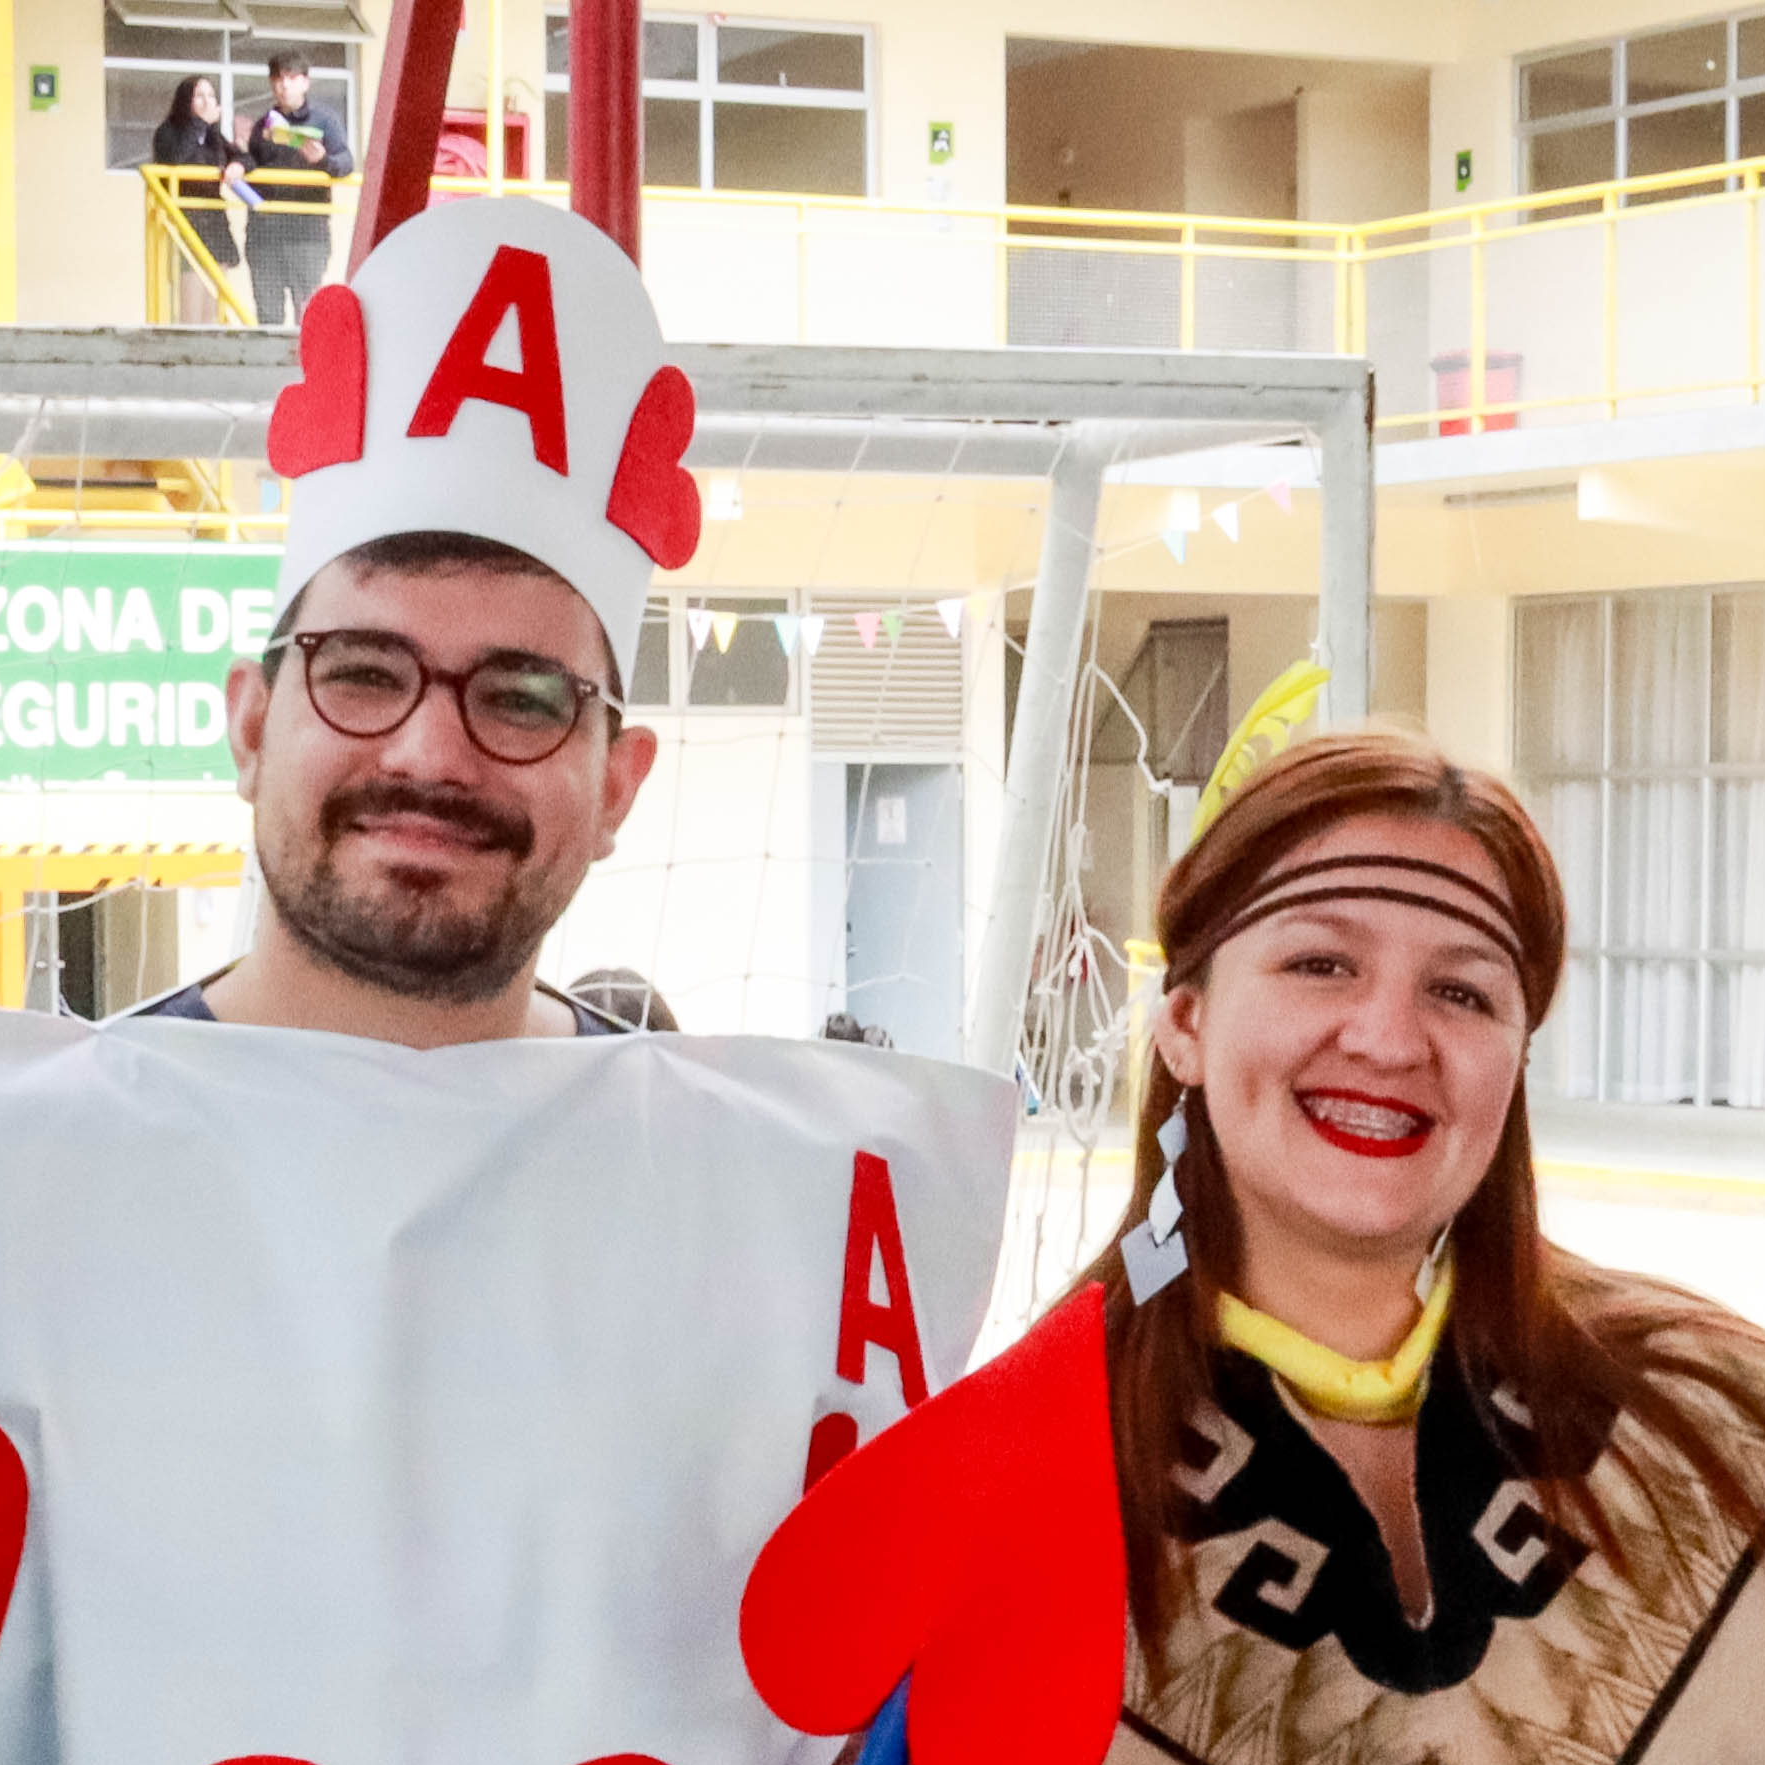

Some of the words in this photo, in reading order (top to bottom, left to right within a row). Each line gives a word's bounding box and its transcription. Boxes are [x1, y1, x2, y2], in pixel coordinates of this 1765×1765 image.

[407, 245, 569, 477] A
[180, 588, 275, 654] DE
[836, 1150, 930, 1408] A
